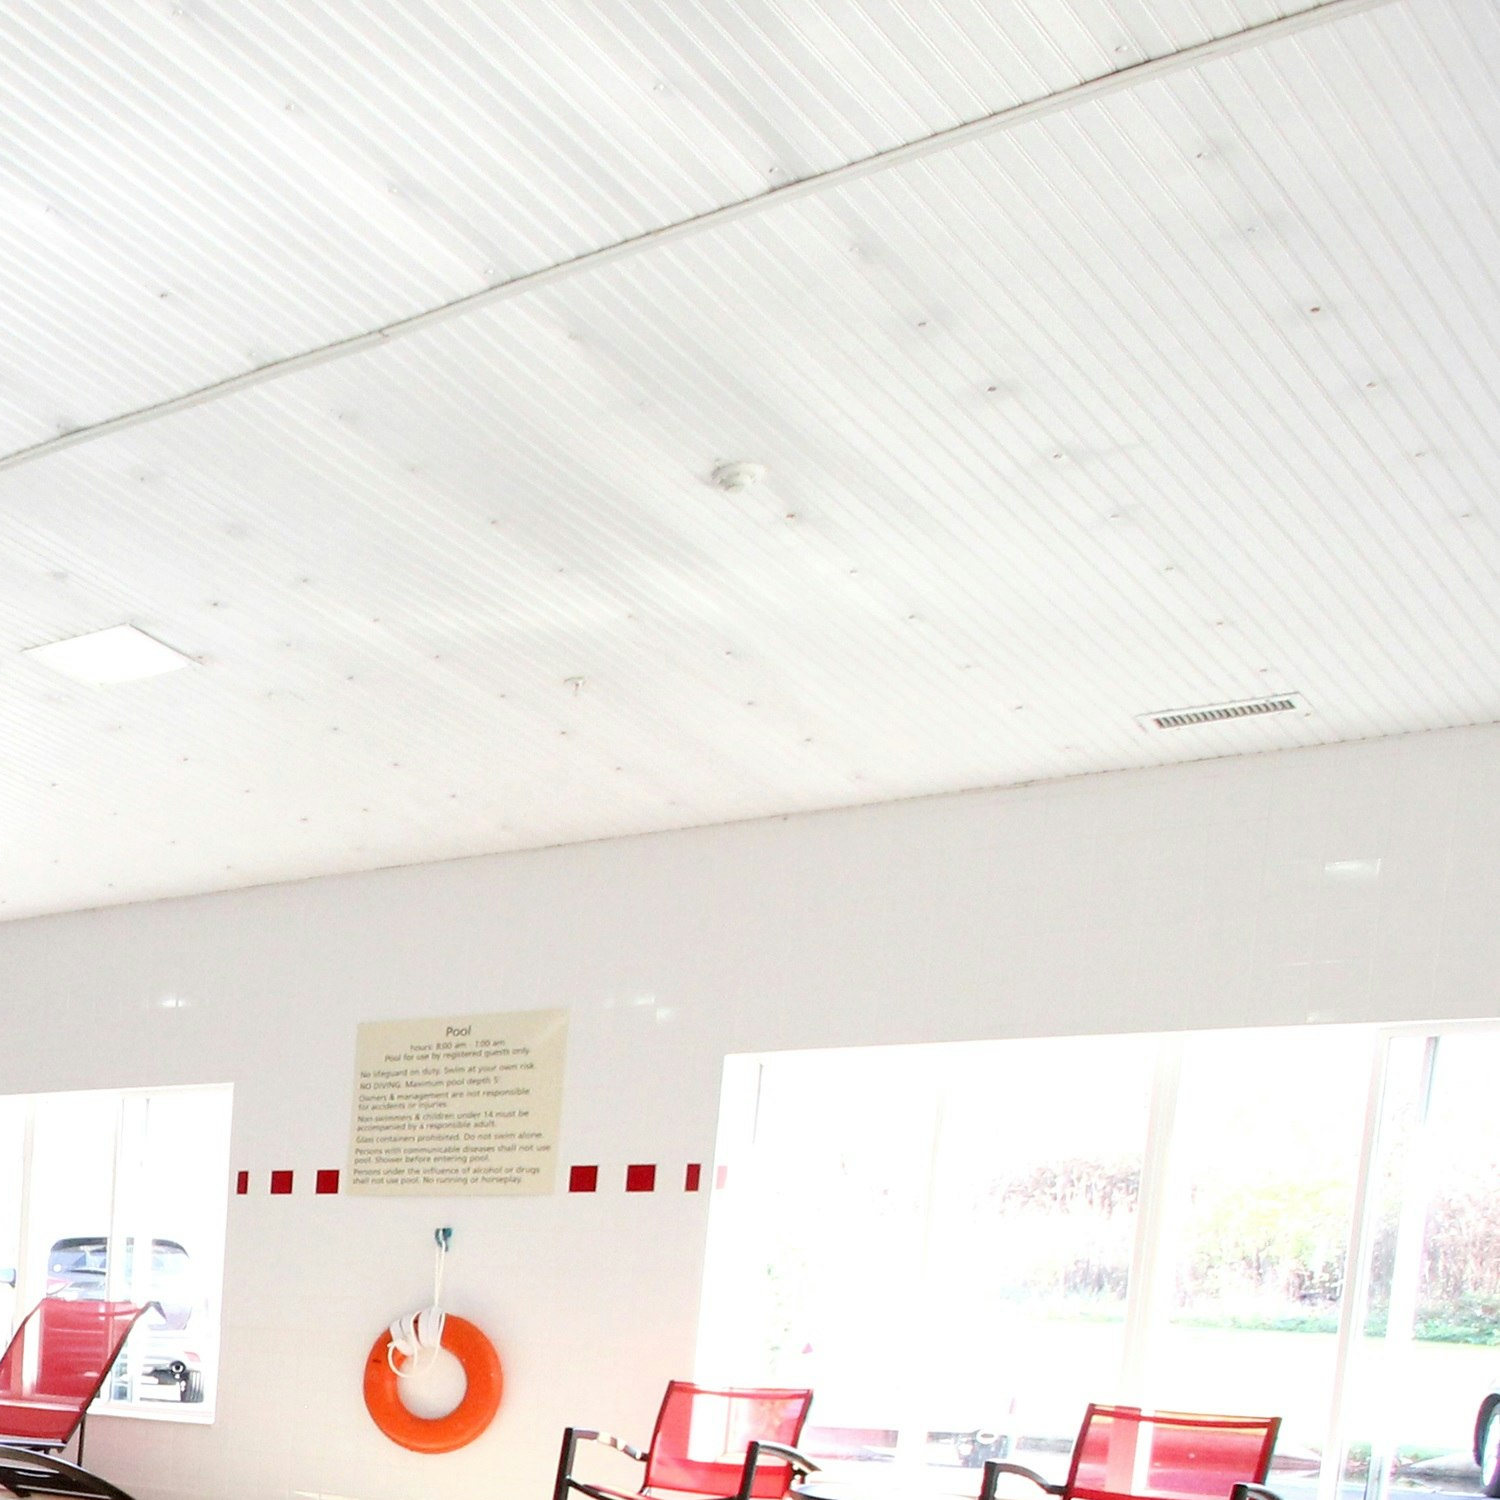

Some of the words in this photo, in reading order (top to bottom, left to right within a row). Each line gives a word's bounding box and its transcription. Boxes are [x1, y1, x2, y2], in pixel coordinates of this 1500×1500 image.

[446, 1025, 471, 1037] Pool
[431, 1053, 440, 1061] by
[443, 1050, 482, 1059] registered
[484, 1049, 510, 1058] guests
[373, 1069, 407, 1078] lifeguard
[405, 1080, 444, 1088] Maximum
[446, 1078, 465, 1087] pool
[467, 1077, 491, 1085] depth
[397, 1092, 448, 1101] management
[482, 1088, 530, 1097] responsible
[357, 1124, 405, 1132] accompanied
[426, 1122, 471, 1130] responsible
[403, 1146, 460, 1154] communicable
[497, 1144, 516, 1152] shall
[433, 1155, 467, 1163] entering
[516, 1166, 540, 1175] drugs
[436, 1176, 467, 1185] running
